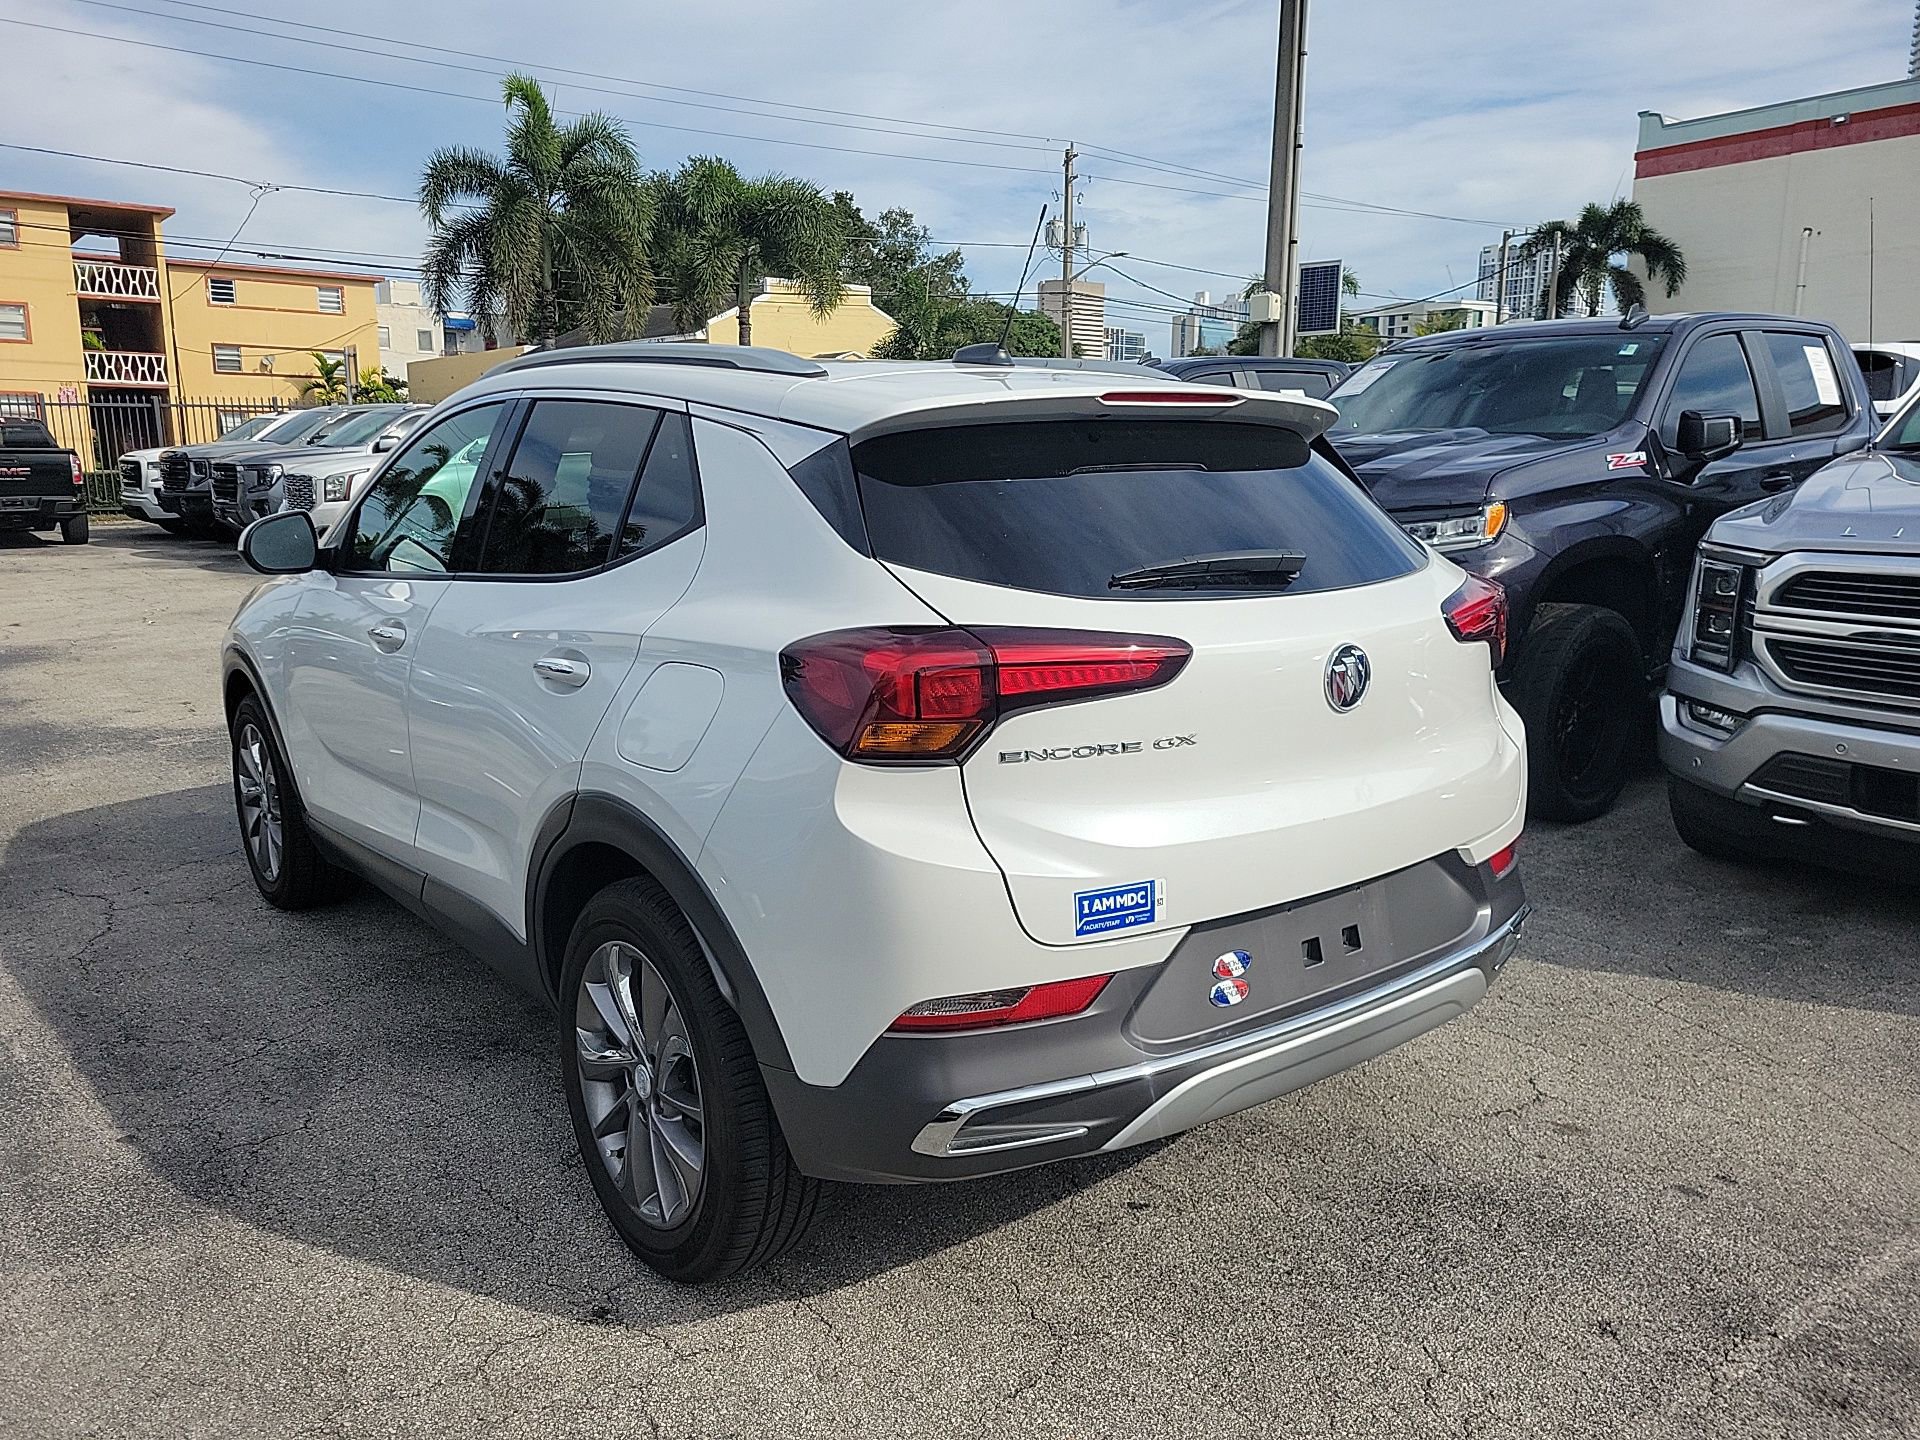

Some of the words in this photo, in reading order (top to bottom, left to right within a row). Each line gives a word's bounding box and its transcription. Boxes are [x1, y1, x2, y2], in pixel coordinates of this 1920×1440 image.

[999, 741, 1143, 764] ENCORE
[1153, 734, 1198, 750] GX
[1082, 900, 1089, 914] I
